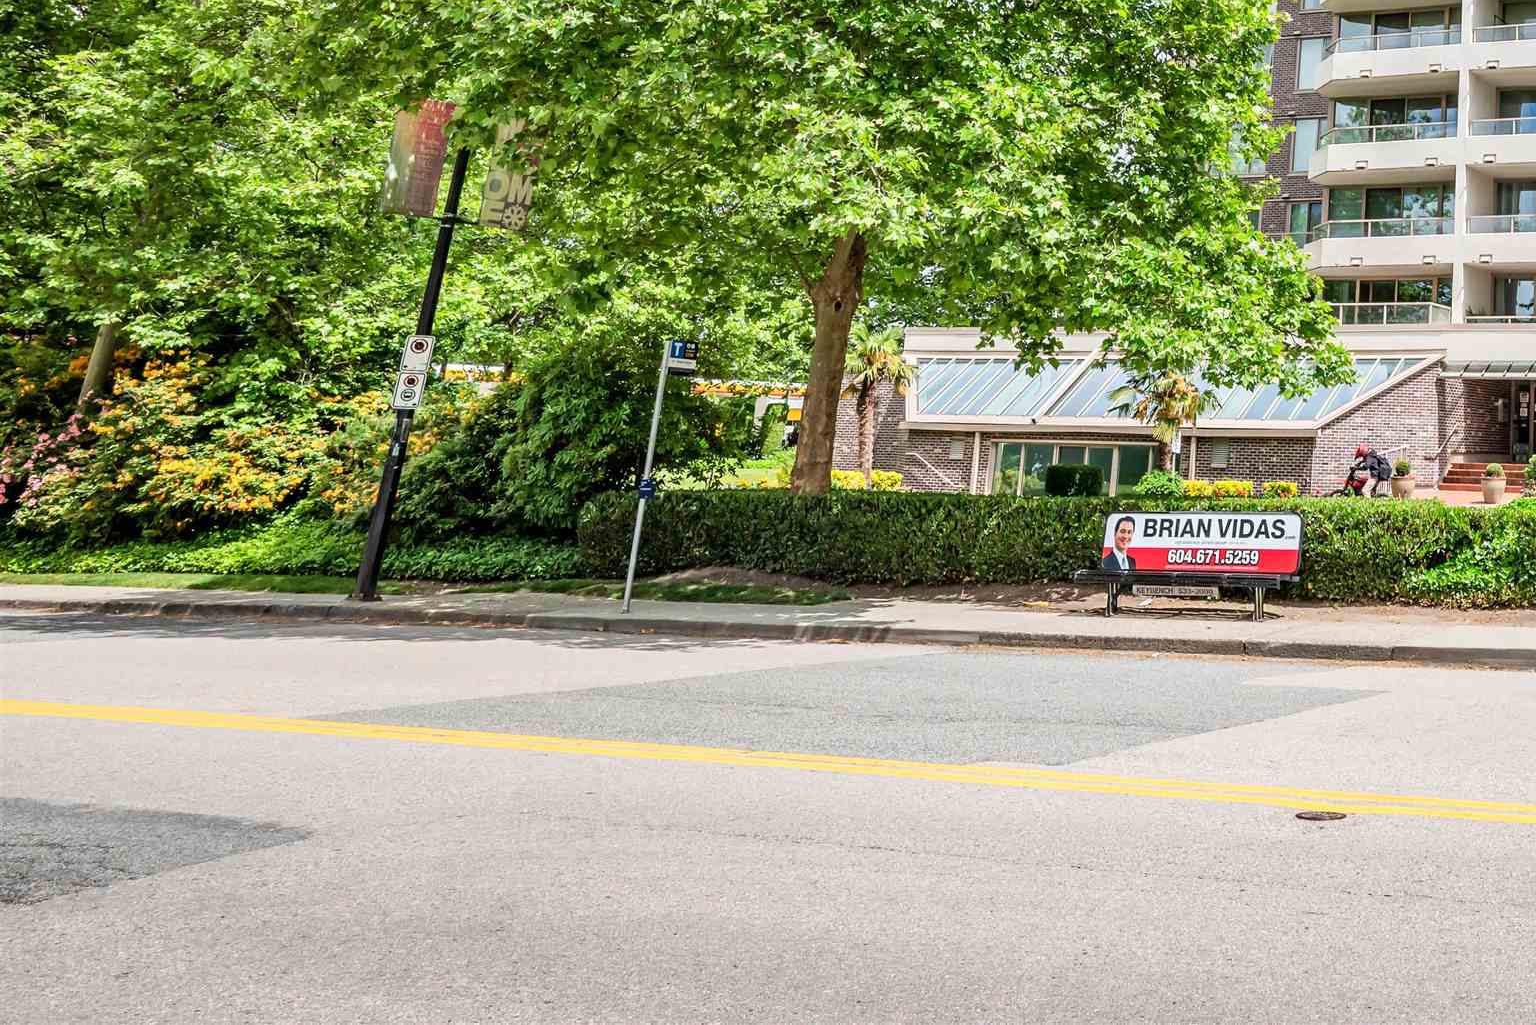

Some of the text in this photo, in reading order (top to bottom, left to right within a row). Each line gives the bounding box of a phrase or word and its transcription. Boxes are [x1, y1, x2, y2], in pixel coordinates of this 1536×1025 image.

[1143, 518, 1213, 538] BRIAN
[1217, 518, 1286, 539] VIDAS
[1167, 549, 1259, 565] 604.671.5259
